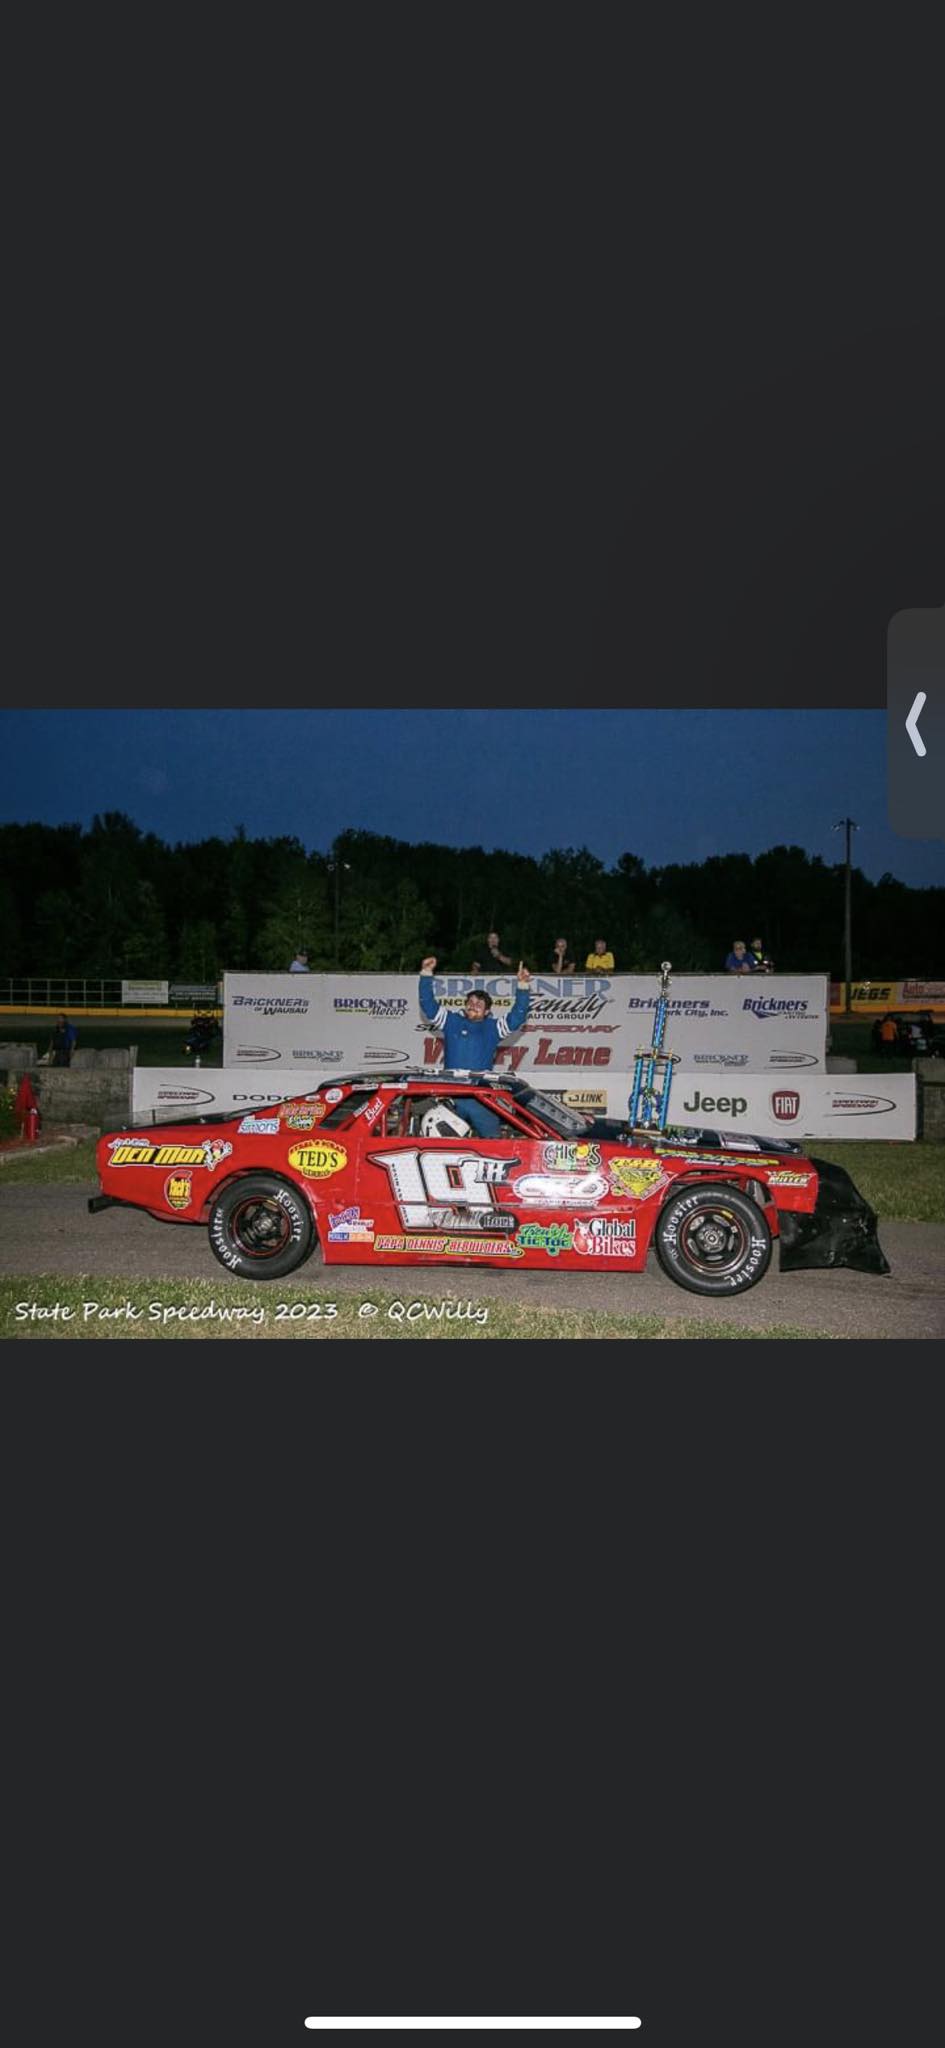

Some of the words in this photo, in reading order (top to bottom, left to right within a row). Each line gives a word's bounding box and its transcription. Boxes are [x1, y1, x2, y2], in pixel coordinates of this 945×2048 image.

[432, 978, 611, 999] BRICNER
[263, 1007, 308, 1016] WAUSAU
[333, 998, 408, 1009] BRICKNER
[368, 1006, 409, 1017] Motors
[438, 998, 466, 1006] INC
[743, 996, 808, 1011] Brickners
[710, 1009, 729, 1017] Inc.
[534, 1038, 611, 1067] Lane
[581, 1093, 603, 1104] LINK
[683, 1091, 747, 1117] Jeep
[775, 1096, 798, 1115] FIAT
[297, 1150, 339, 1168] TED'S
[273, 1188, 304, 1243] Hoosier
[663, 1196, 698, 1245] Hoosier
[589, 1218, 635, 1238] Global
[211, 1216, 242, 1269] Hoosier
[590, 1236, 635, 1256] Bikes
[724, 1236, 767, 1286] Hoosier
